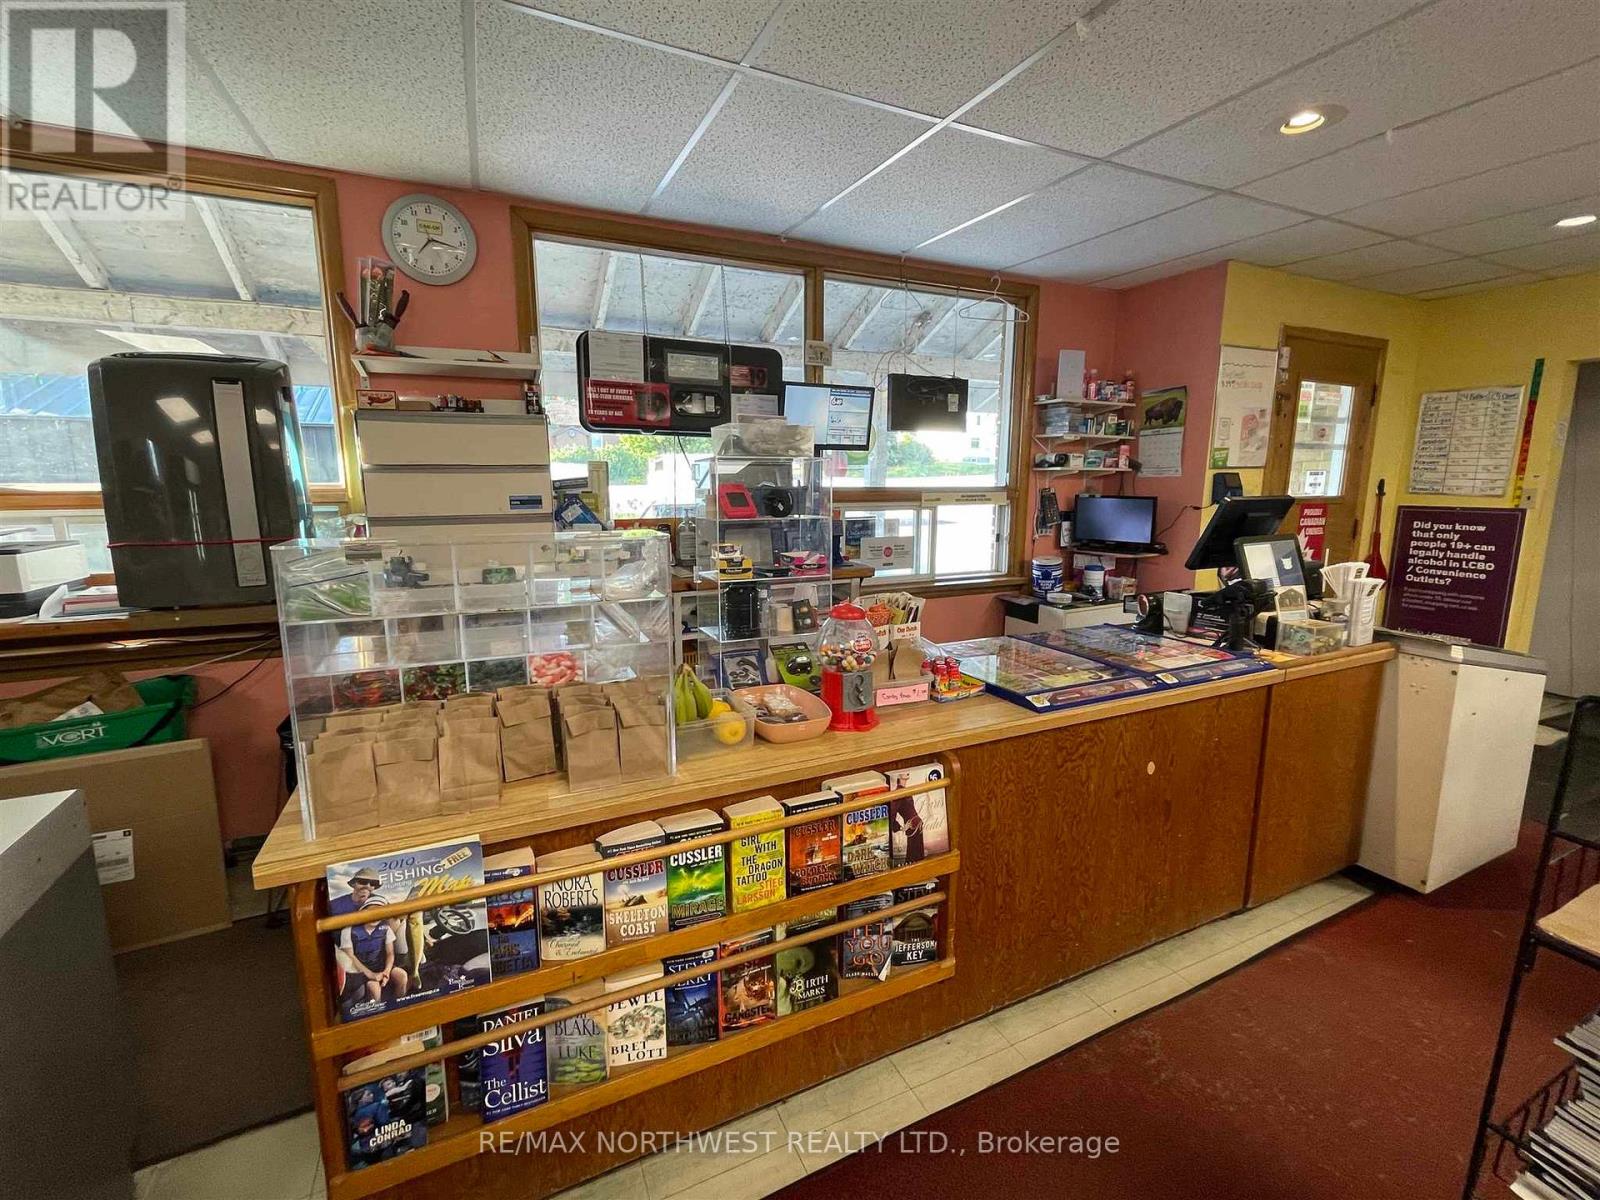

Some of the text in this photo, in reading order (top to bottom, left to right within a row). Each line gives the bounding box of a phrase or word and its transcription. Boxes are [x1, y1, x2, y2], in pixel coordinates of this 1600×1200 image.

[1413, 521, 1486, 532] Did you know
[1436, 532, 1460, 540] only
[1410, 540, 1447, 548] people
[1409, 548, 1486, 560] legally handle
[1408, 558, 1495, 571] alcohol in LCBO
[1406, 575, 1452, 585] Outlets?
[1416, 567, 1487, 580] Convenience
[846, 805, 888, 825] CUSSLER
[794, 819, 836, 837] CUSSLER
[740, 835, 761, 848] GIRL
[755, 840, 777, 854] WITH
[447, 852, 467, 865] FREE
[670, 845, 722, 867] CUSSLER
[742, 855, 757, 866] THE
[848, 847, 874, 862] DARK
[607, 858, 664, 882] CUSSLER
[748, 858, 783, 875] DRAGON
[795, 864, 829, 877] GOLDEN
[853, 858, 888, 874] WATCH
[378, 864, 444, 884] FISHING
[736, 872, 767, 886] TATTOO
[552, 875, 592, 892] NORA
[759, 878, 783, 891] STIEG
[544, 888, 598, 908] ROBERTS
[737, 889, 776, 905] LARSSON
[609, 905, 666, 925] SKELETON
[671, 897, 724, 918] MIRAGE
[620, 922, 657, 937] COAST
[848, 936, 892, 952] YOU
[896, 940, 935, 952] JEFFERSON
[907, 950, 924, 960] KEY
[790, 974, 829, 993] BIRTH
[798, 985, 825, 1000] MARKS
[608, 991, 663, 1012] JEWEL
[611, 1041, 648, 1055] BRET
[628, 1048, 665, 1062] LOTT
[484, 1077, 506, 1090] The
[484, 1079, 547, 1109] Cellist
[375, 1119, 406, 1136] LINDA
[369, 1124, 412, 1147] CONRAD
